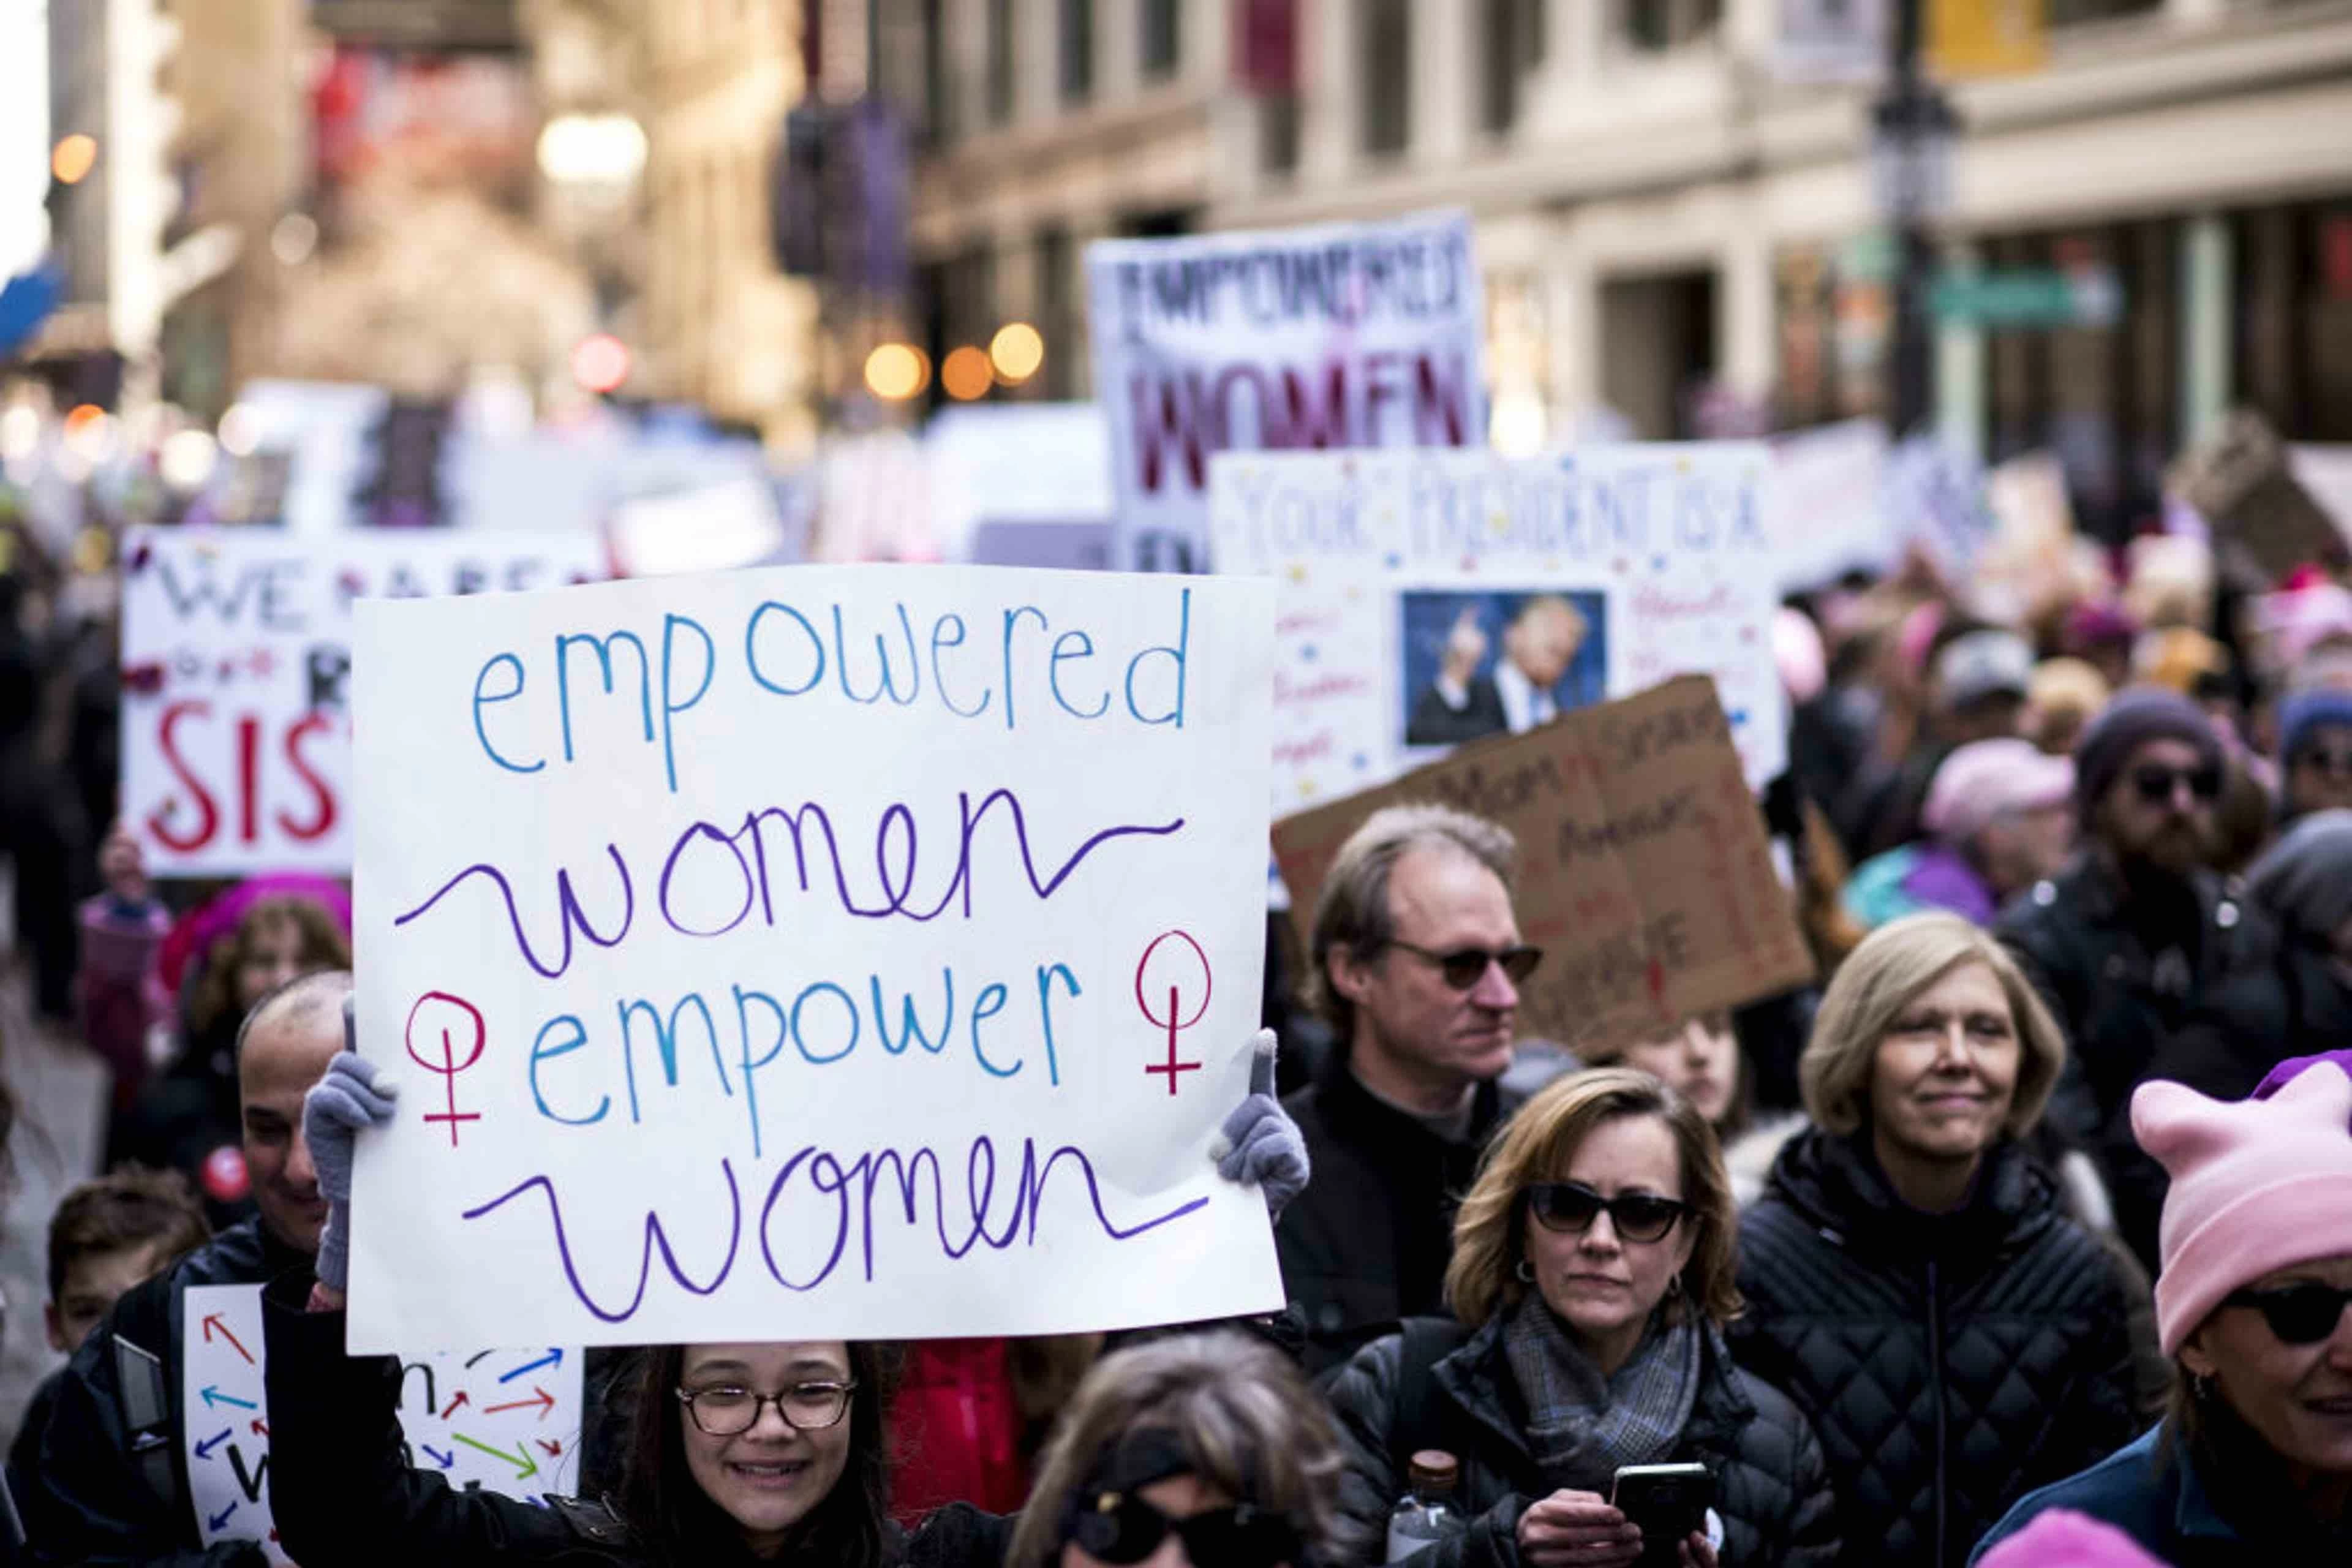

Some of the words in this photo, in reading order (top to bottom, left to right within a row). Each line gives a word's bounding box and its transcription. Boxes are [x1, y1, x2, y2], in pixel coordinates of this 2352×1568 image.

[1131, 352, 1466, 494] WOMEN
[157, 559, 309, 631] WE
[147, 699, 353, 854] SIS
[472, 587, 1191, 794] empowered
[394, 788, 1186, 979] women
[528, 962, 1083, 1158] empower
[461, 1135, 1210, 1324] women
